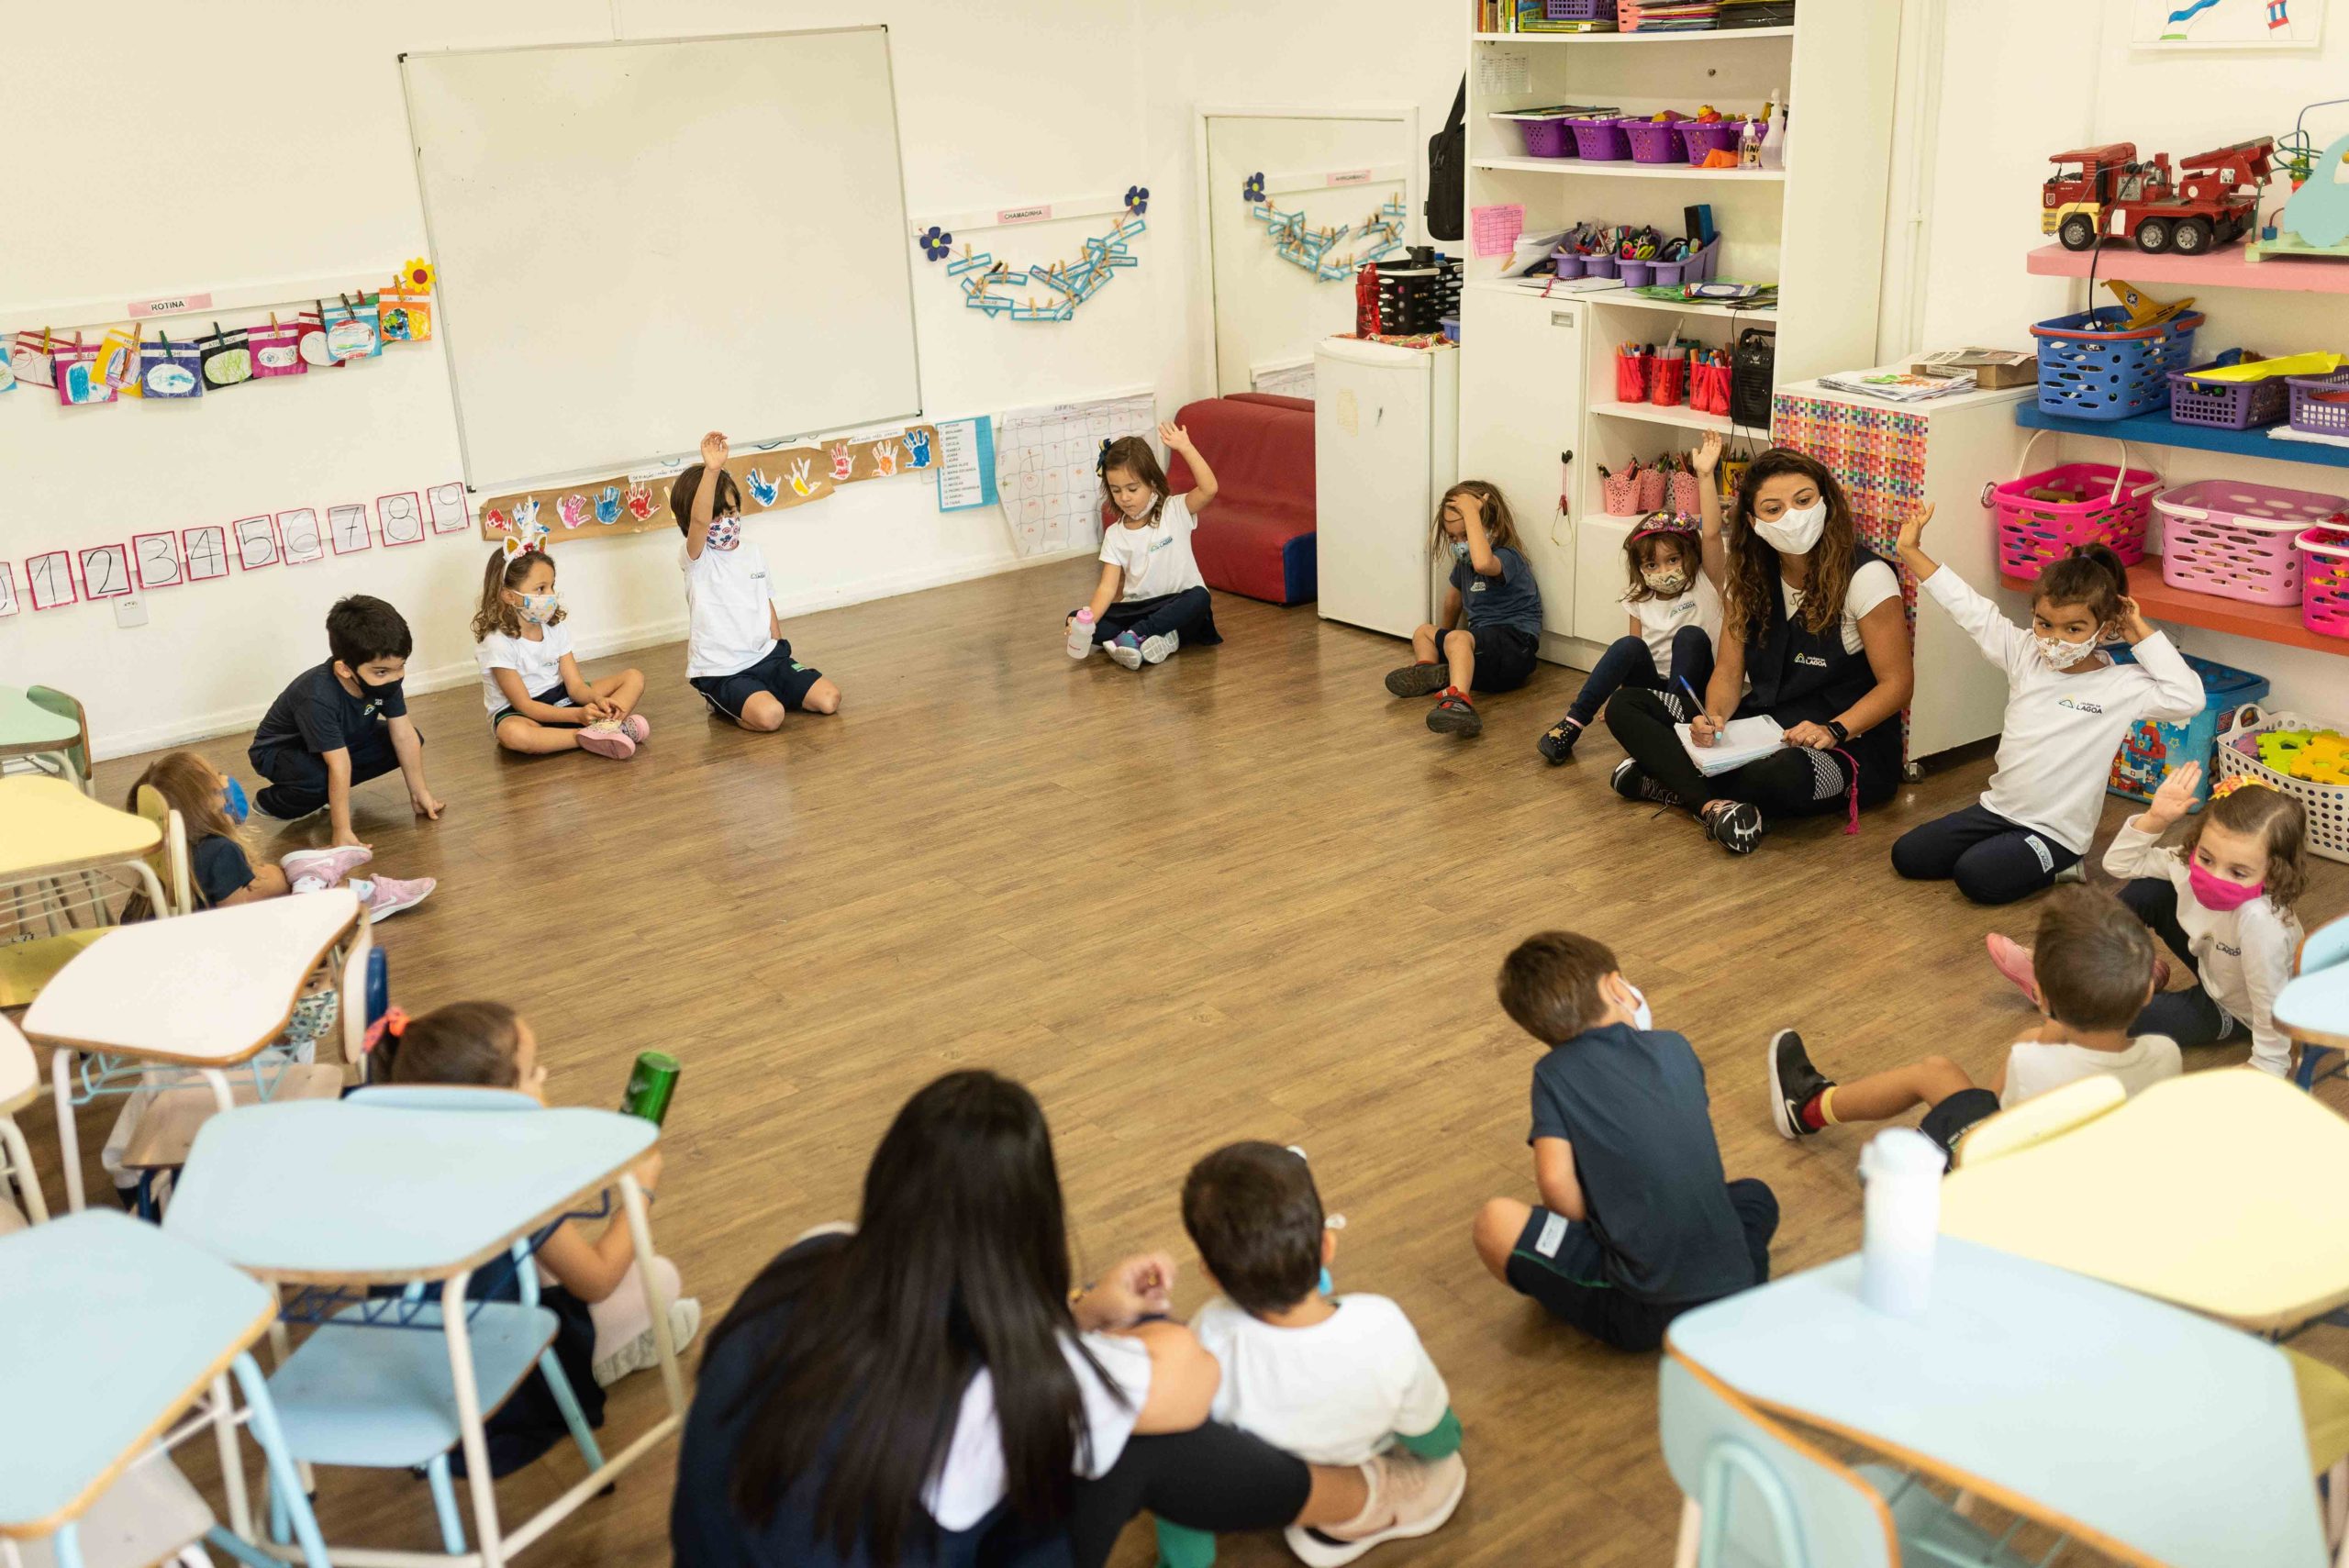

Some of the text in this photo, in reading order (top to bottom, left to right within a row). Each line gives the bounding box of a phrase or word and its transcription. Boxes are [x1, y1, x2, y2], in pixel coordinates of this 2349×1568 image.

[1004, 209, 1042, 219] CHAMADINHA
[151, 300, 185, 311] ROTINA
[334, 506, 359, 548] 7
[387, 496, 418, 541] 8
[438, 484, 462, 527] 9
[190, 529, 221, 575] 4
[240, 518, 273, 565] 5
[287, 510, 319, 553] 6
[35, 555, 56, 605] 1
[86, 550, 128, 595] 2
[141, 538, 179, 584] 3
[1805, 659, 1827, 668] LAGOA
[2076, 705, 2102, 714] LAGOA
